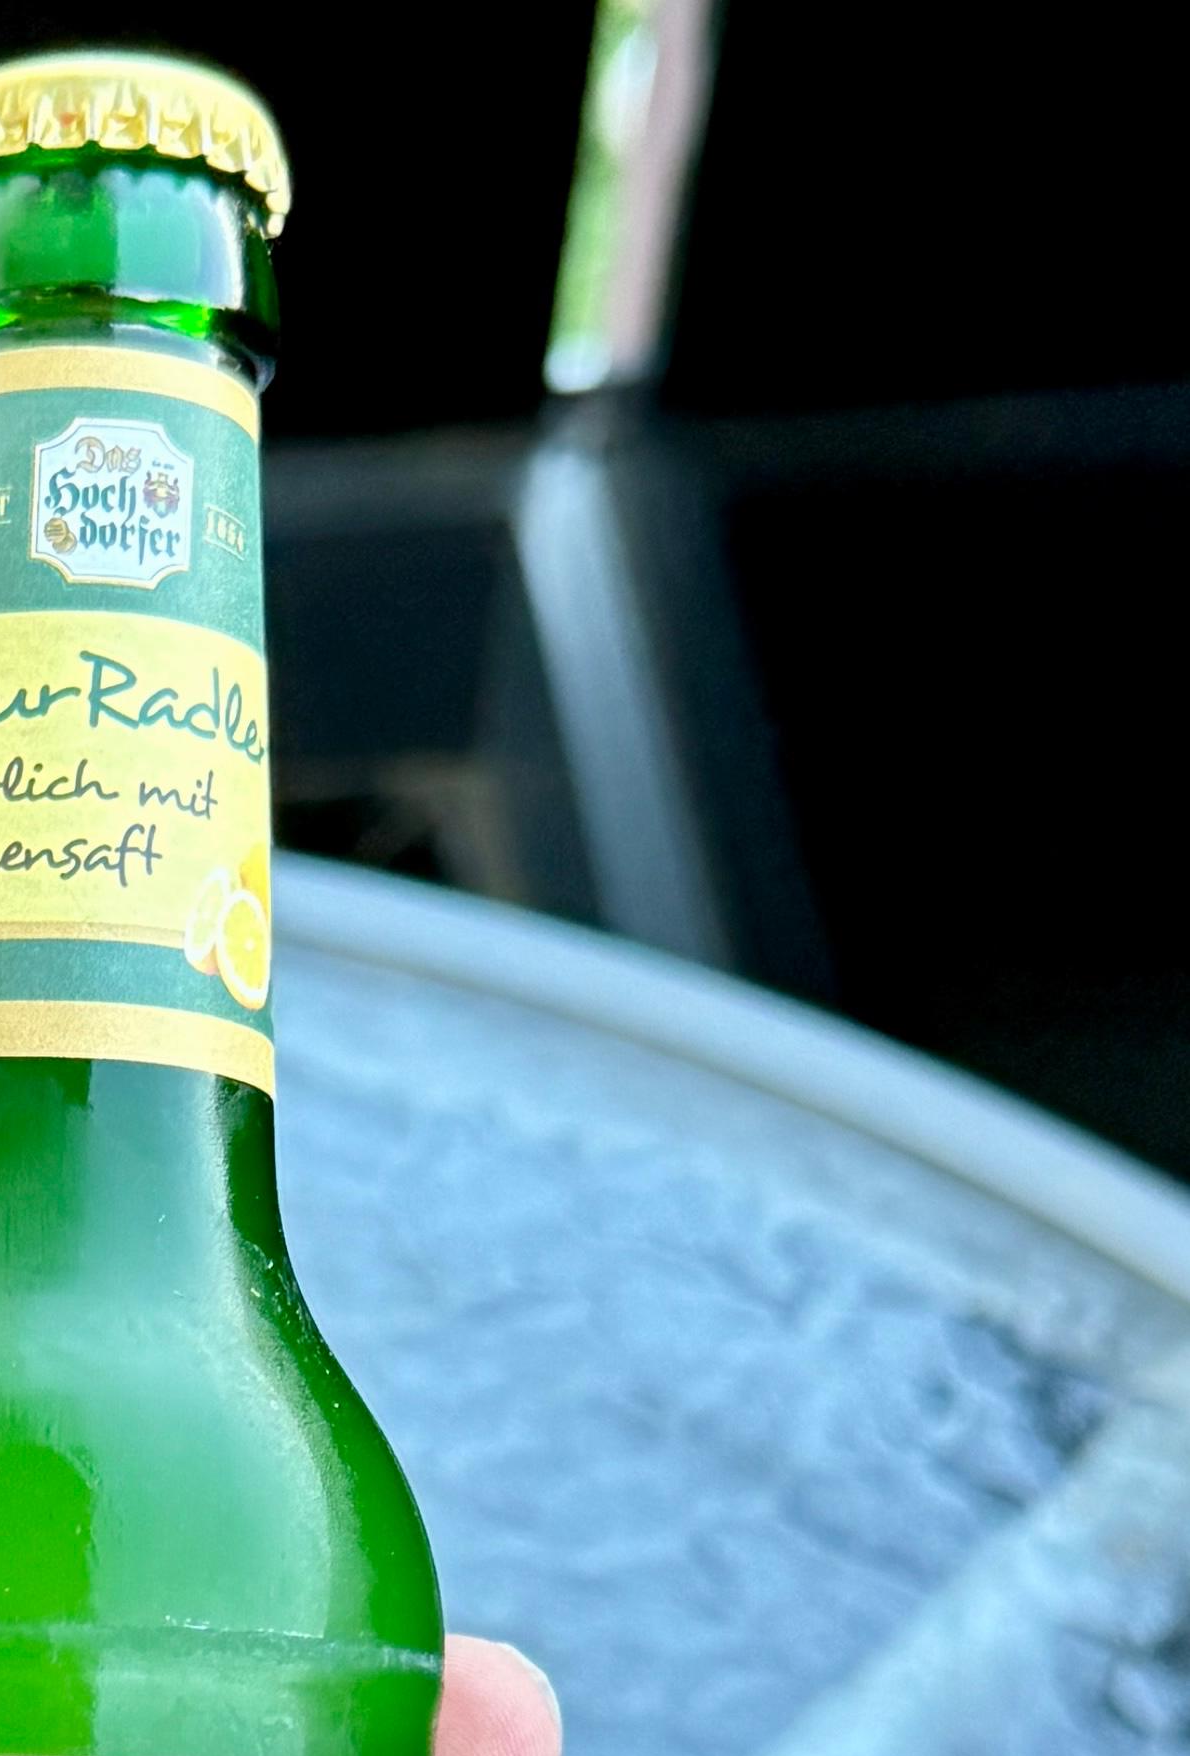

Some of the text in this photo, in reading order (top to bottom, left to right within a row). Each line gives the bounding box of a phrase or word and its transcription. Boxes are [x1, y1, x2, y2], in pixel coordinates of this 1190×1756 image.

[75, 436, 142, 475] Das
[44, 467, 136, 523] Hoch
[79, 512, 181, 565] dorfer
[139, 770, 218, 819] mit
